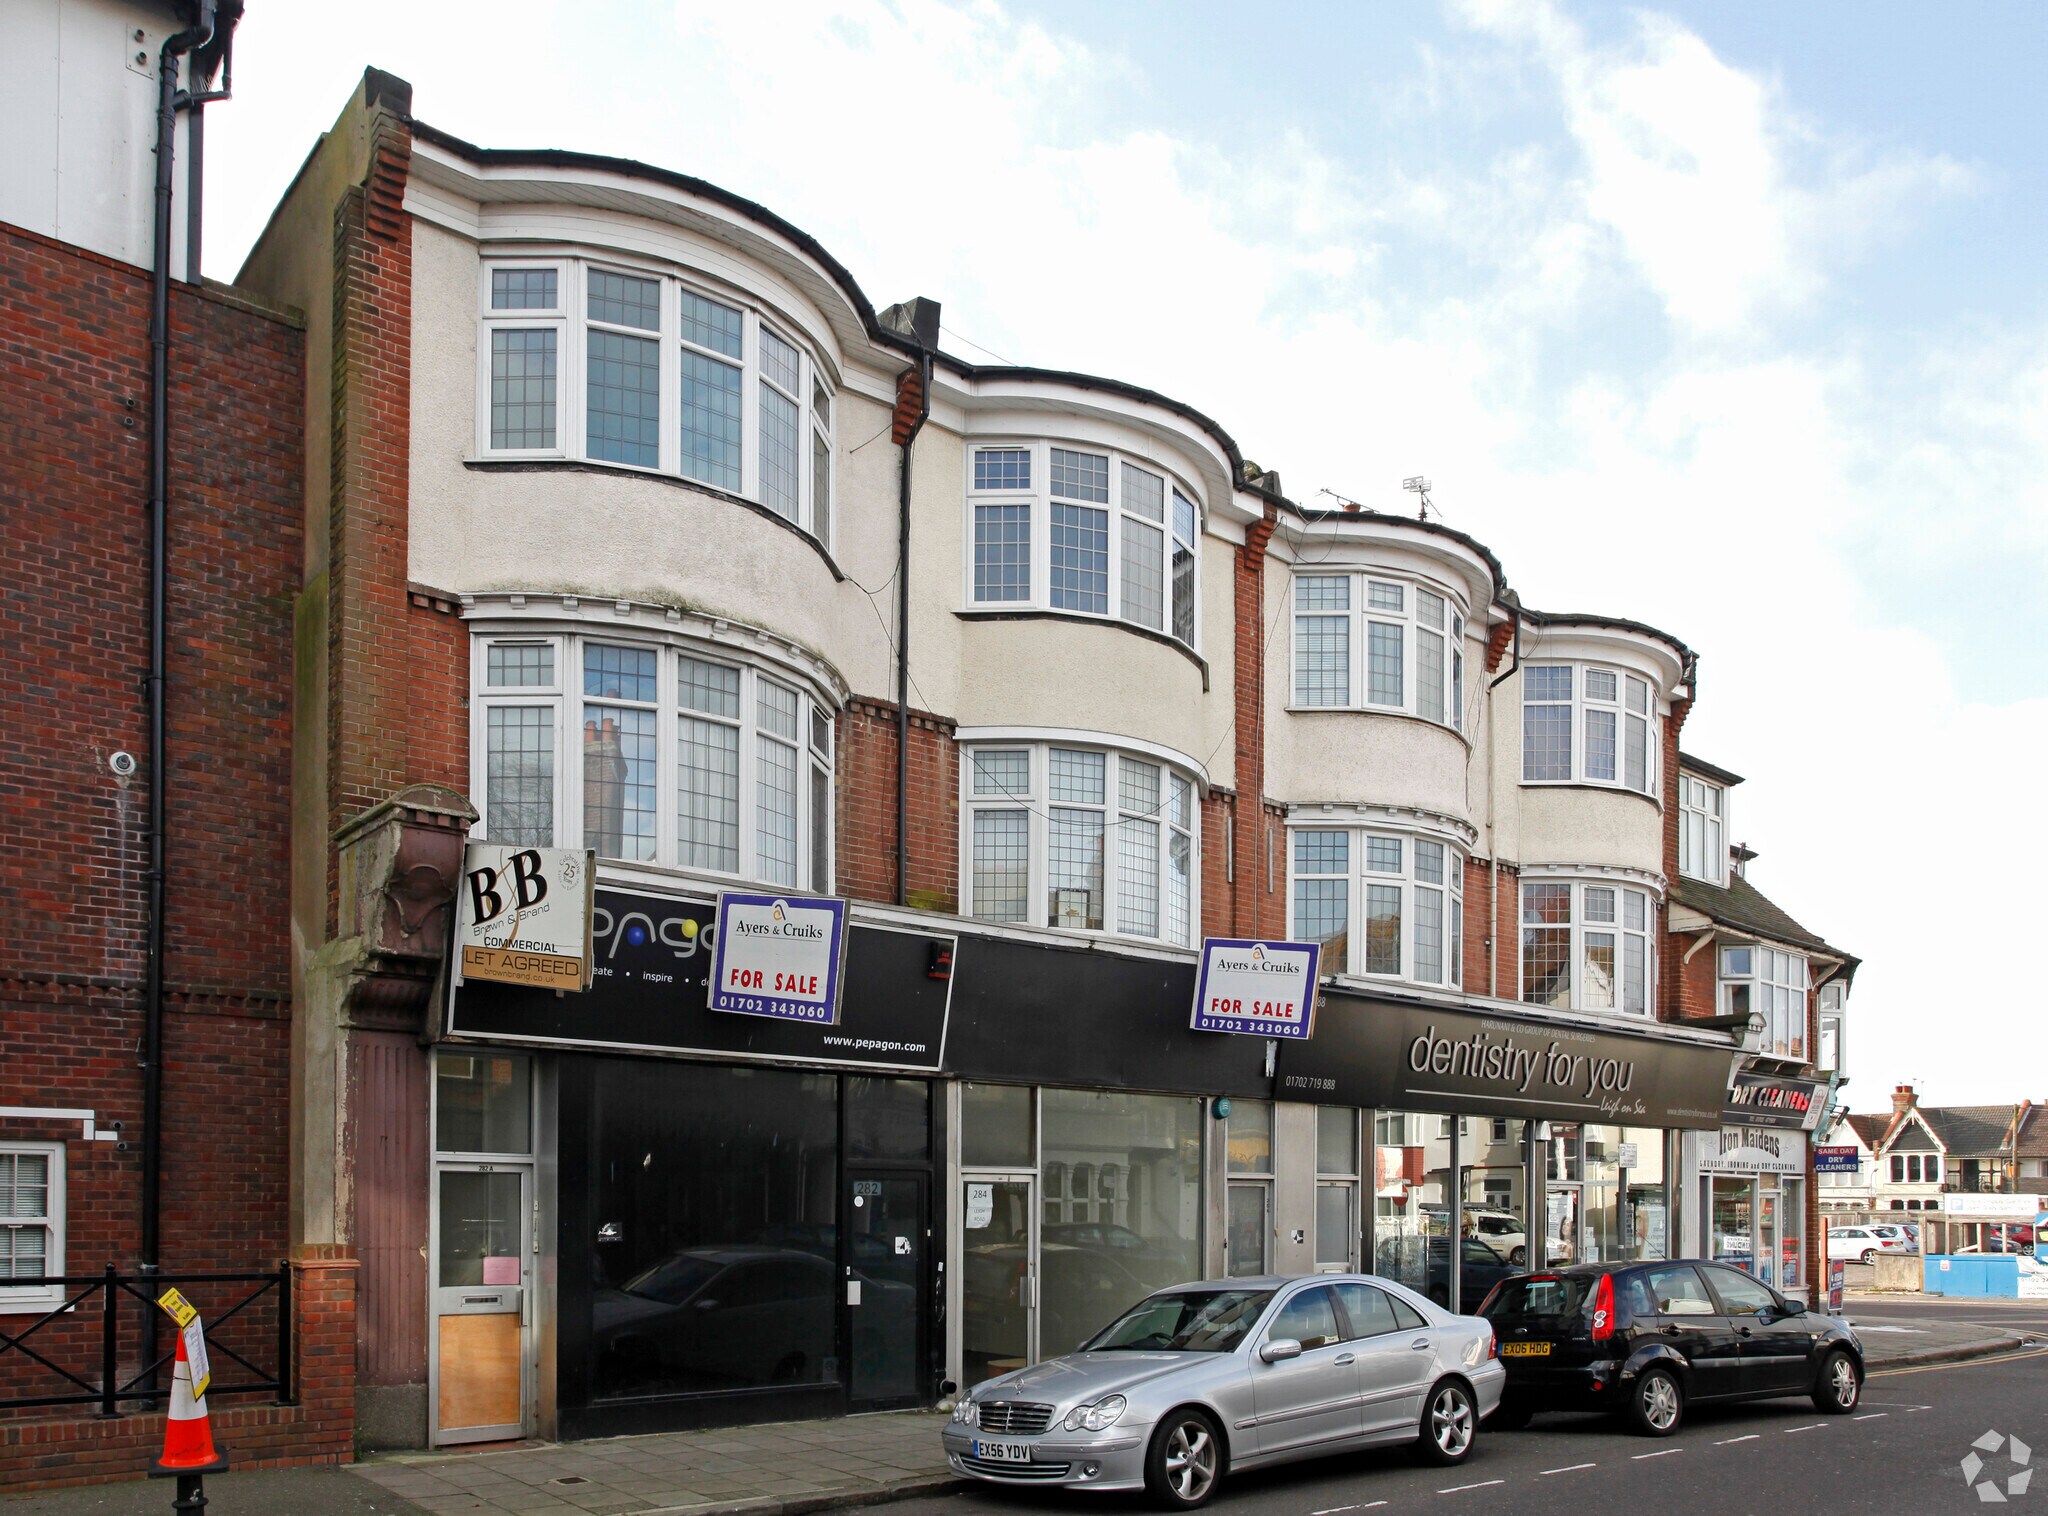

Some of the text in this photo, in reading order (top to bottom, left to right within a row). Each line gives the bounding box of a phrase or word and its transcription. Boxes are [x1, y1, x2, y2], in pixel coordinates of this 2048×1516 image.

[563, 863, 576, 878] 25
[473, 902, 550, 937] Brown & Brand
[736, 919, 823, 939] Ayers & Cruiks
[484, 936, 558, 953] COMMERCIAL
[465, 950, 580, 977] LET AGREED
[1217, 958, 1300, 974] Ayers & Cruiks
[484, 967, 556, 984] brownbrand.co.uk
[642, 971, 674, 983] inspire
[730, 968, 818, 995] FOR SALE
[720, 996, 825, 1019] 01702 343060
[1211, 998, 1294, 1018] FOR SALE
[1202, 1018, 1300, 1035] 01702 343060
[1516, 1024, 1524, 1034] CO
[1524, 1025, 1543, 1036] GROUP
[1543, 1028, 1551, 1037] OF
[1551, 1029, 1570, 1039] DENTAL
[1570, 1031, 1596, 1043] SURGERIES
[823, 1035, 926, 1053] www.pepagon.com
[1409, 1026, 1634, 1098] dentistry for you
[1286, 1075, 1336, 1091] 01702 719 888
[1730, 1084, 1757, 1105] DRY
[1757, 1087, 1812, 1111] CLEANERS
[1600, 1096, 1647, 1119] Leigh on Sea
[1719, 1126, 1780, 1159] Iron Maidens
[1727, 1161, 1749, 1169] IRONING
[1772, 1163, 1796, 1171] CLEANING
[857, 1182, 878, 1194] 282
[973, 1190, 987, 1199] 284
[1504, 1343, 1549, 1354] EX06 HDG
[979, 1442, 1028, 1459] EX56 YDV
